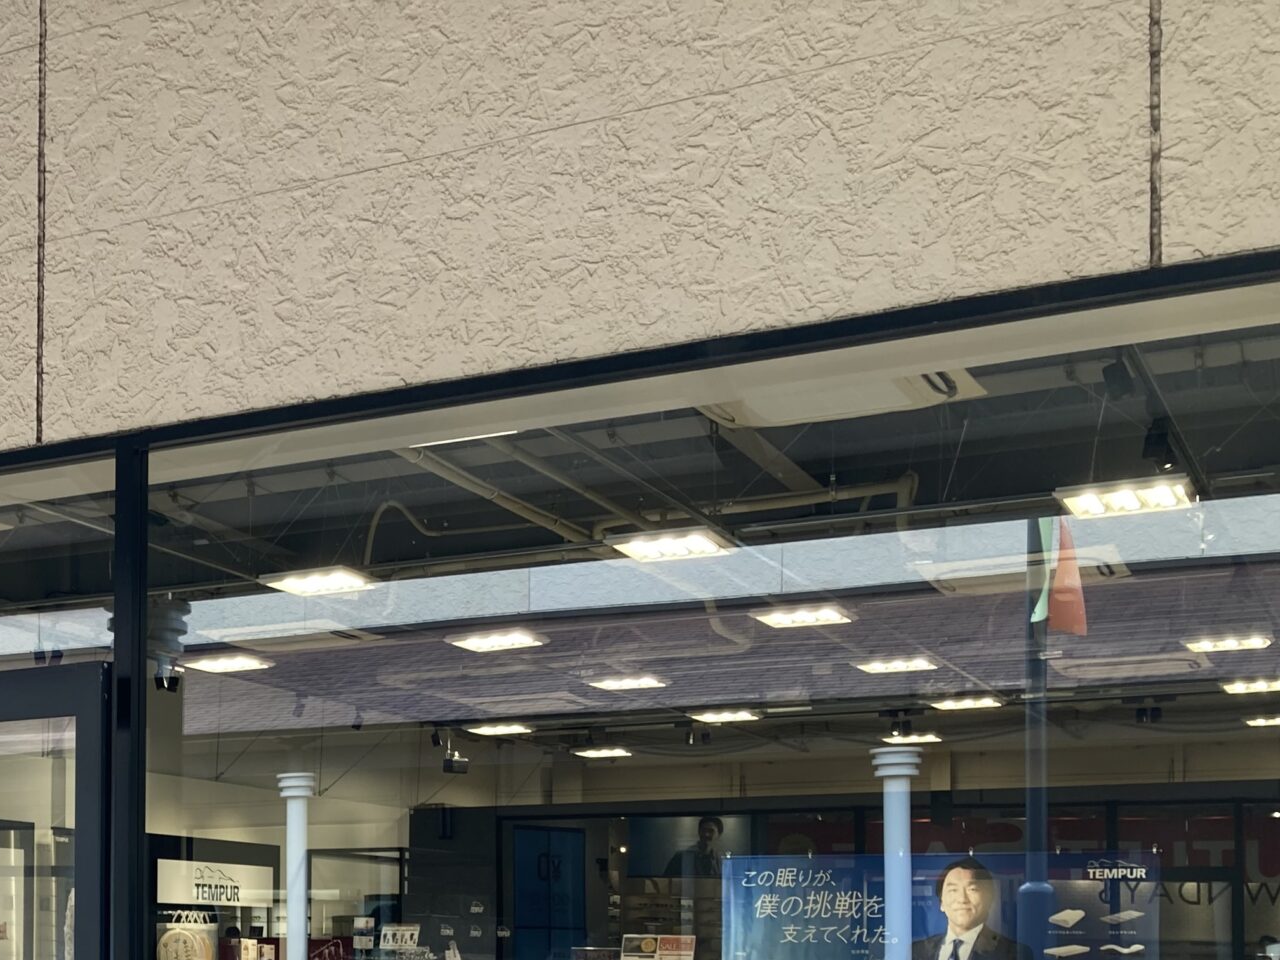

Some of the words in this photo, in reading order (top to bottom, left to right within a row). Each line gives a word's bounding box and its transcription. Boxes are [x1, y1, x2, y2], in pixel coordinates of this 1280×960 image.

[741, 867, 837, 888] この眠りが、
[1087, 868, 1147, 880] TEMPUR
[194, 883, 241, 903] TEMPUR
[754, 891, 886, 920] 僕の挑戦を
[780, 924, 899, 945] 支えてくれた。
